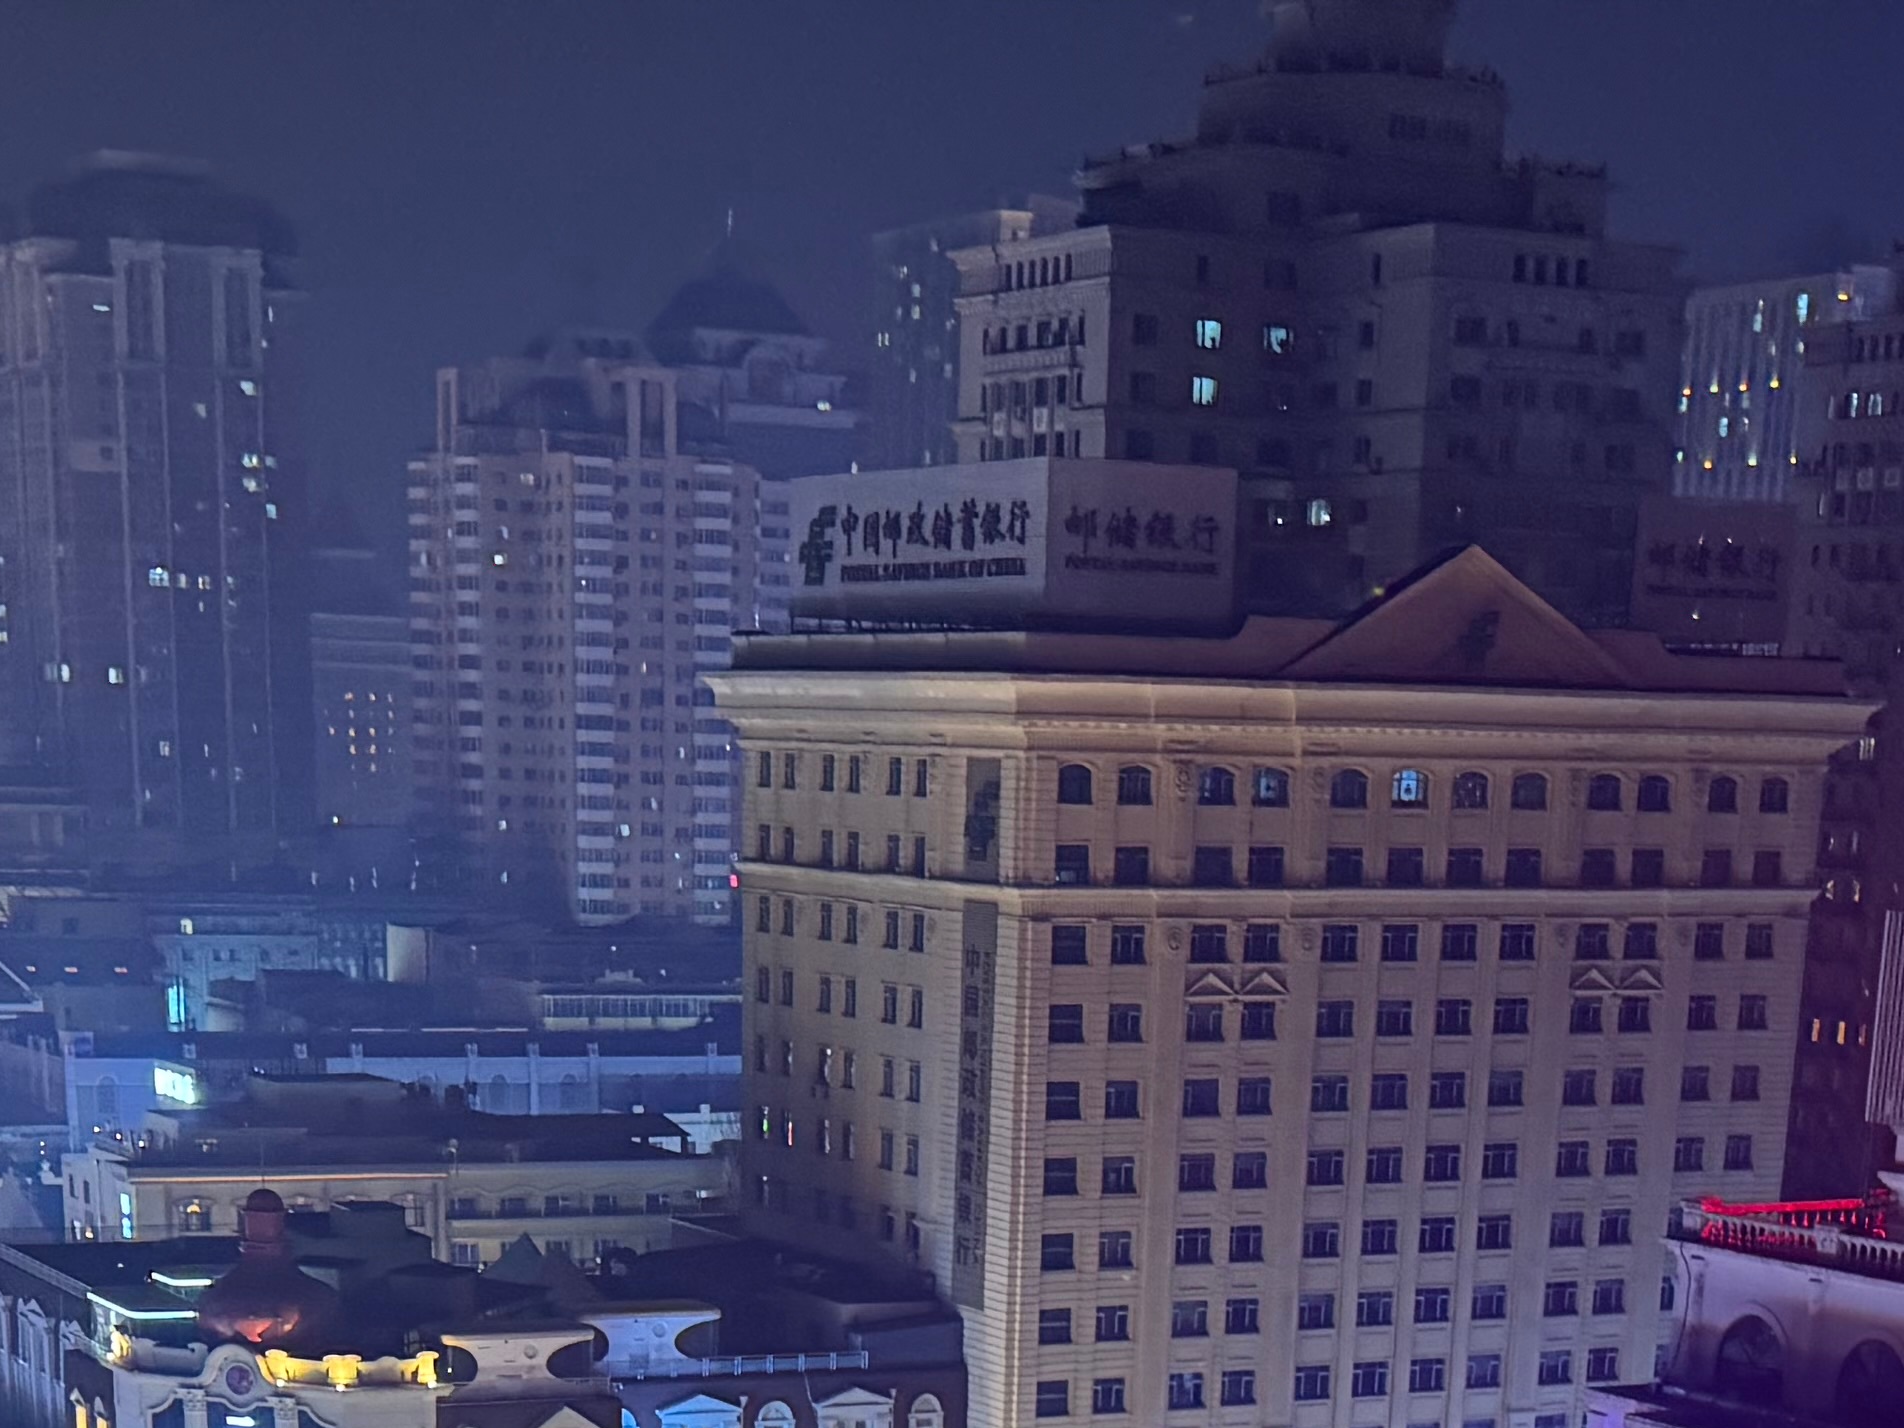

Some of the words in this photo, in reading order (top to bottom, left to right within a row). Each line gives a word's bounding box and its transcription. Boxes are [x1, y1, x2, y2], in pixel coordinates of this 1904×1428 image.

[841, 498, 1031, 558] 中国邮政储蓄银行
